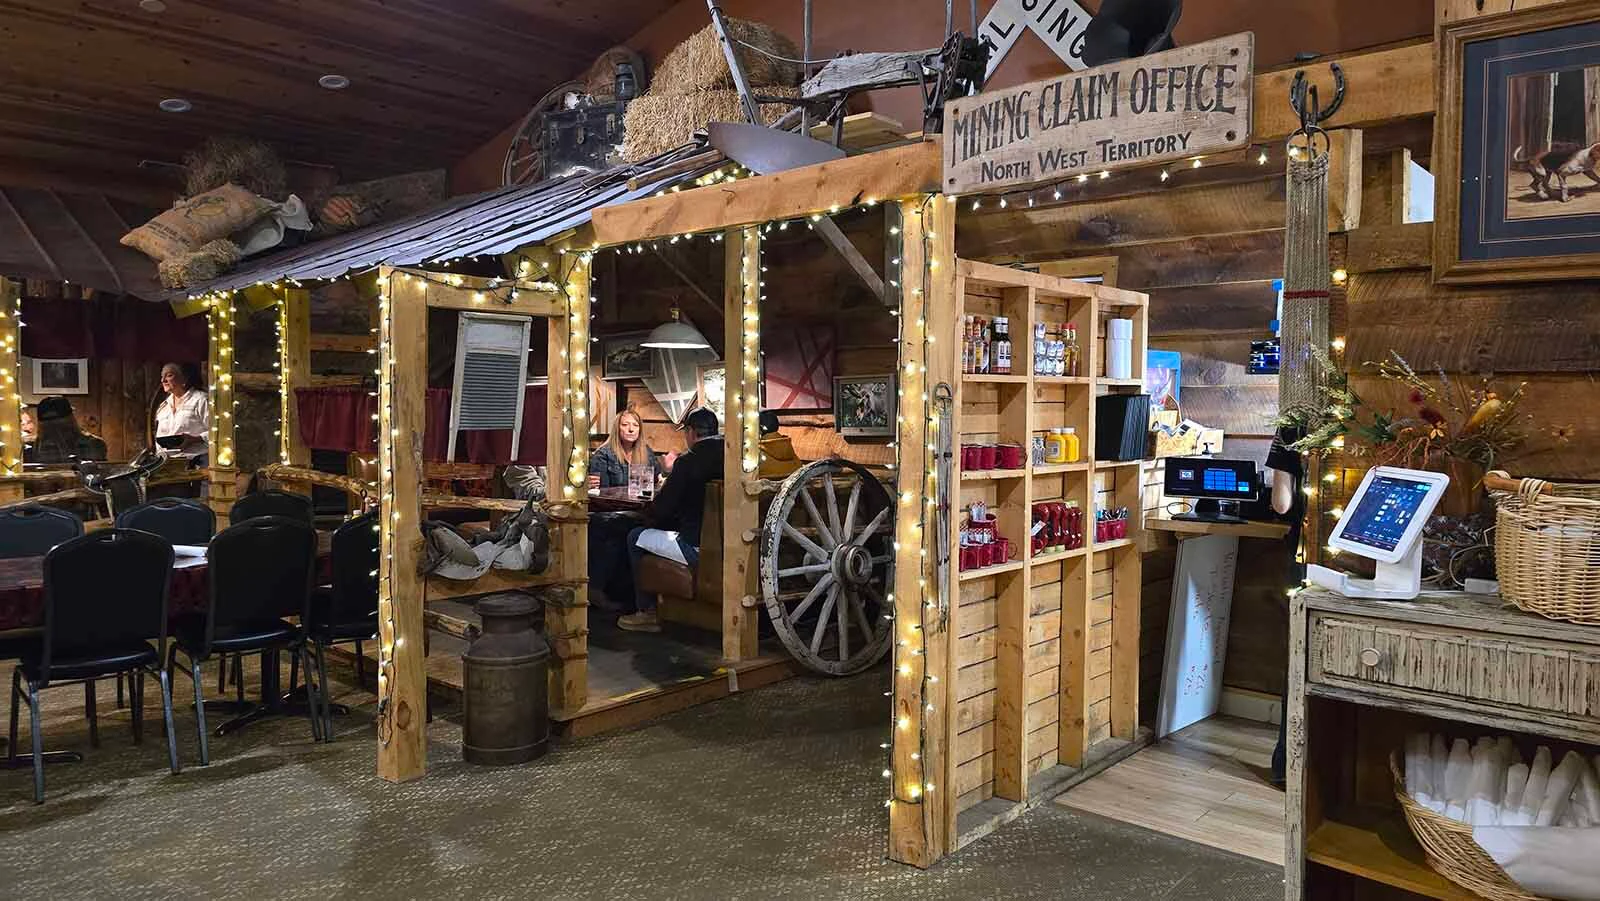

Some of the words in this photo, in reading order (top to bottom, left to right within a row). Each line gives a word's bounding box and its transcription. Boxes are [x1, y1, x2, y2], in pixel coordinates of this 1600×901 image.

[952, 90, 1031, 168] MINING
[1037, 71, 1120, 131] CLAIM
[1130, 63, 1237, 115] OFFICE
[981, 160, 1031, 183] NORTH
[1038, 147, 1087, 174] WEST
[1096, 131, 1192, 163] TERRITORY
